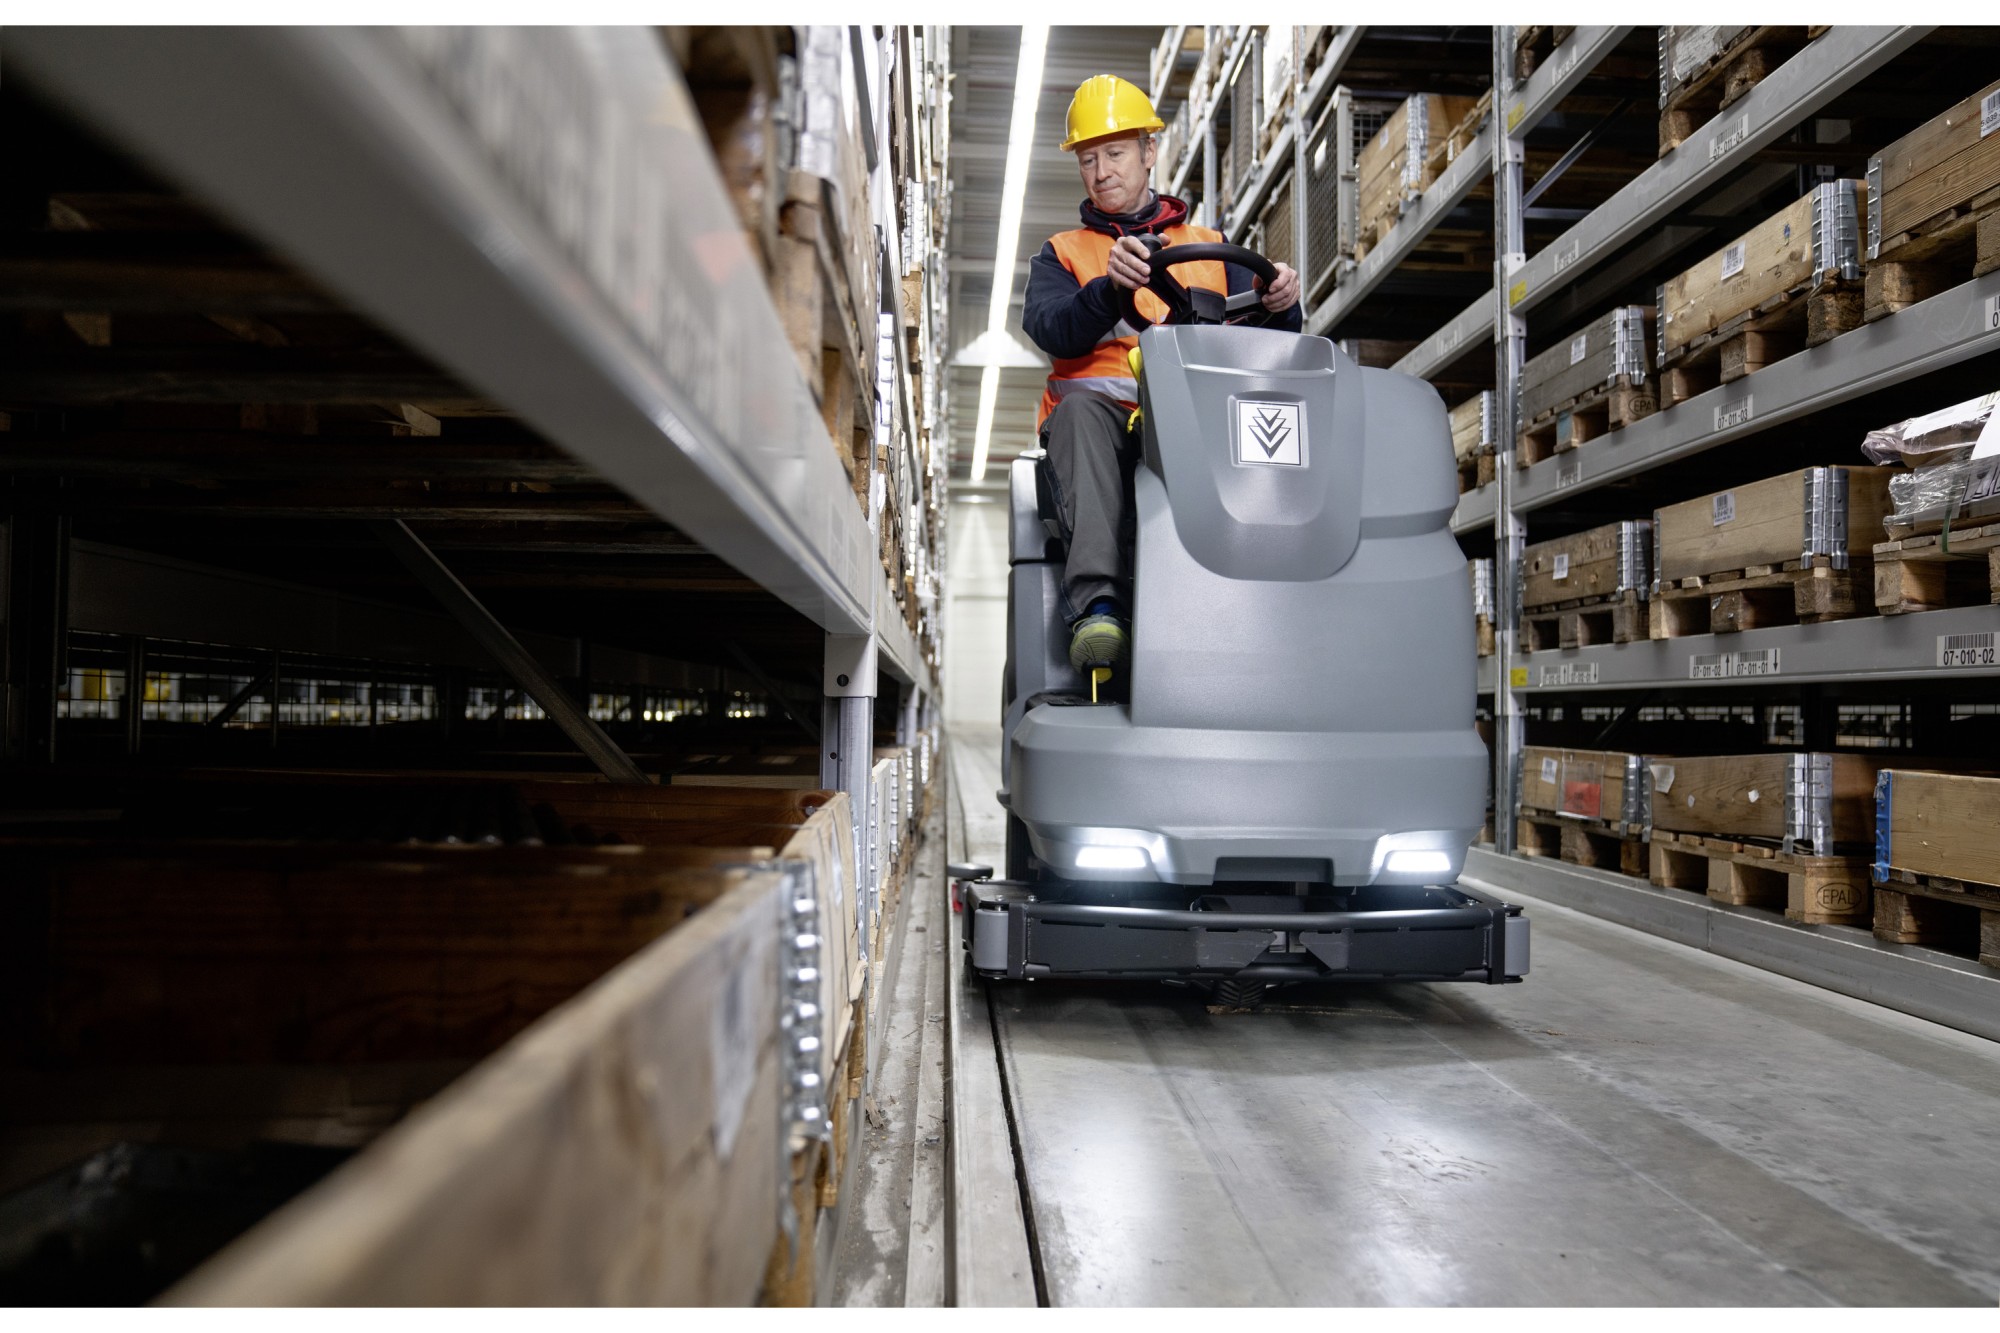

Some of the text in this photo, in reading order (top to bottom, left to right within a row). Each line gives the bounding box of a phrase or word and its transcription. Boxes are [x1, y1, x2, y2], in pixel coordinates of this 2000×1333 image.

[1718, 409, 1748, 429] 07-011-03
[1943, 648, 1995, 666] 07-010-02
[1693, 664, 1721, 678] 07-011-02
[1737, 661, 1768, 676] 07-011-01
[1822, 889, 1856, 905] EPAL
